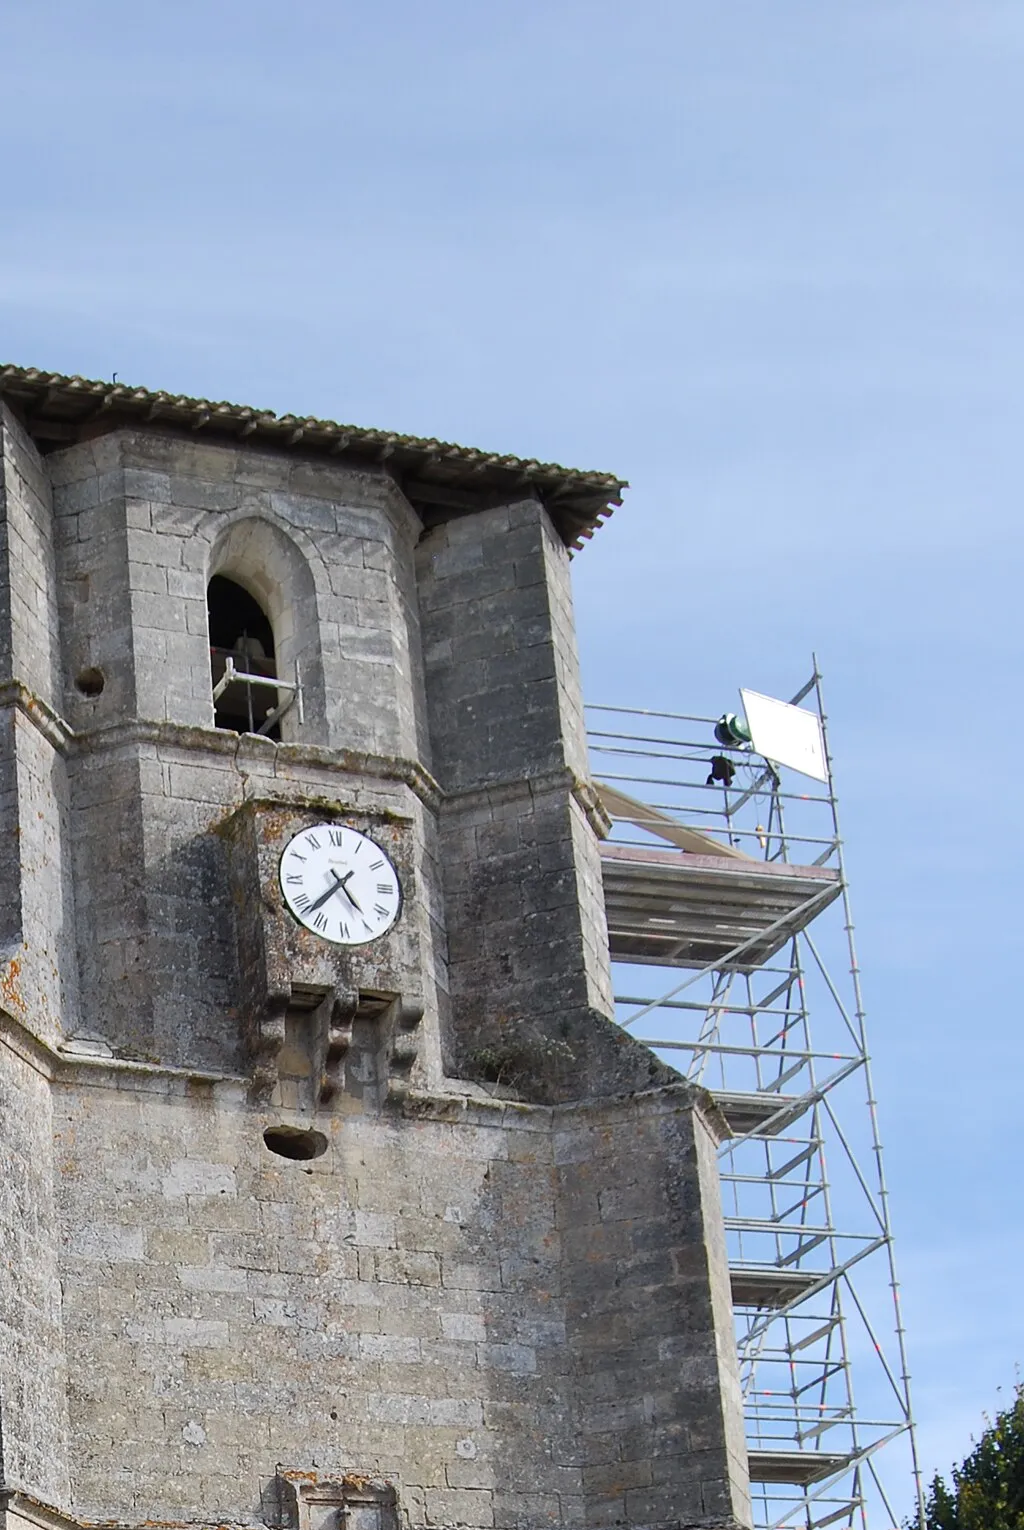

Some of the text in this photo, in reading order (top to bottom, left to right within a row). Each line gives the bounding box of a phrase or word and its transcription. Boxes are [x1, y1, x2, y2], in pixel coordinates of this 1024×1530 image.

[304, 833, 321, 852] XI
[328, 830, 342, 847] XII
[354, 840, 363, 854] I
[289, 849, 307, 864] X
[369, 860, 384, 871] II
[286, 872, 303, 885] IX
[376, 883, 394, 895] III
